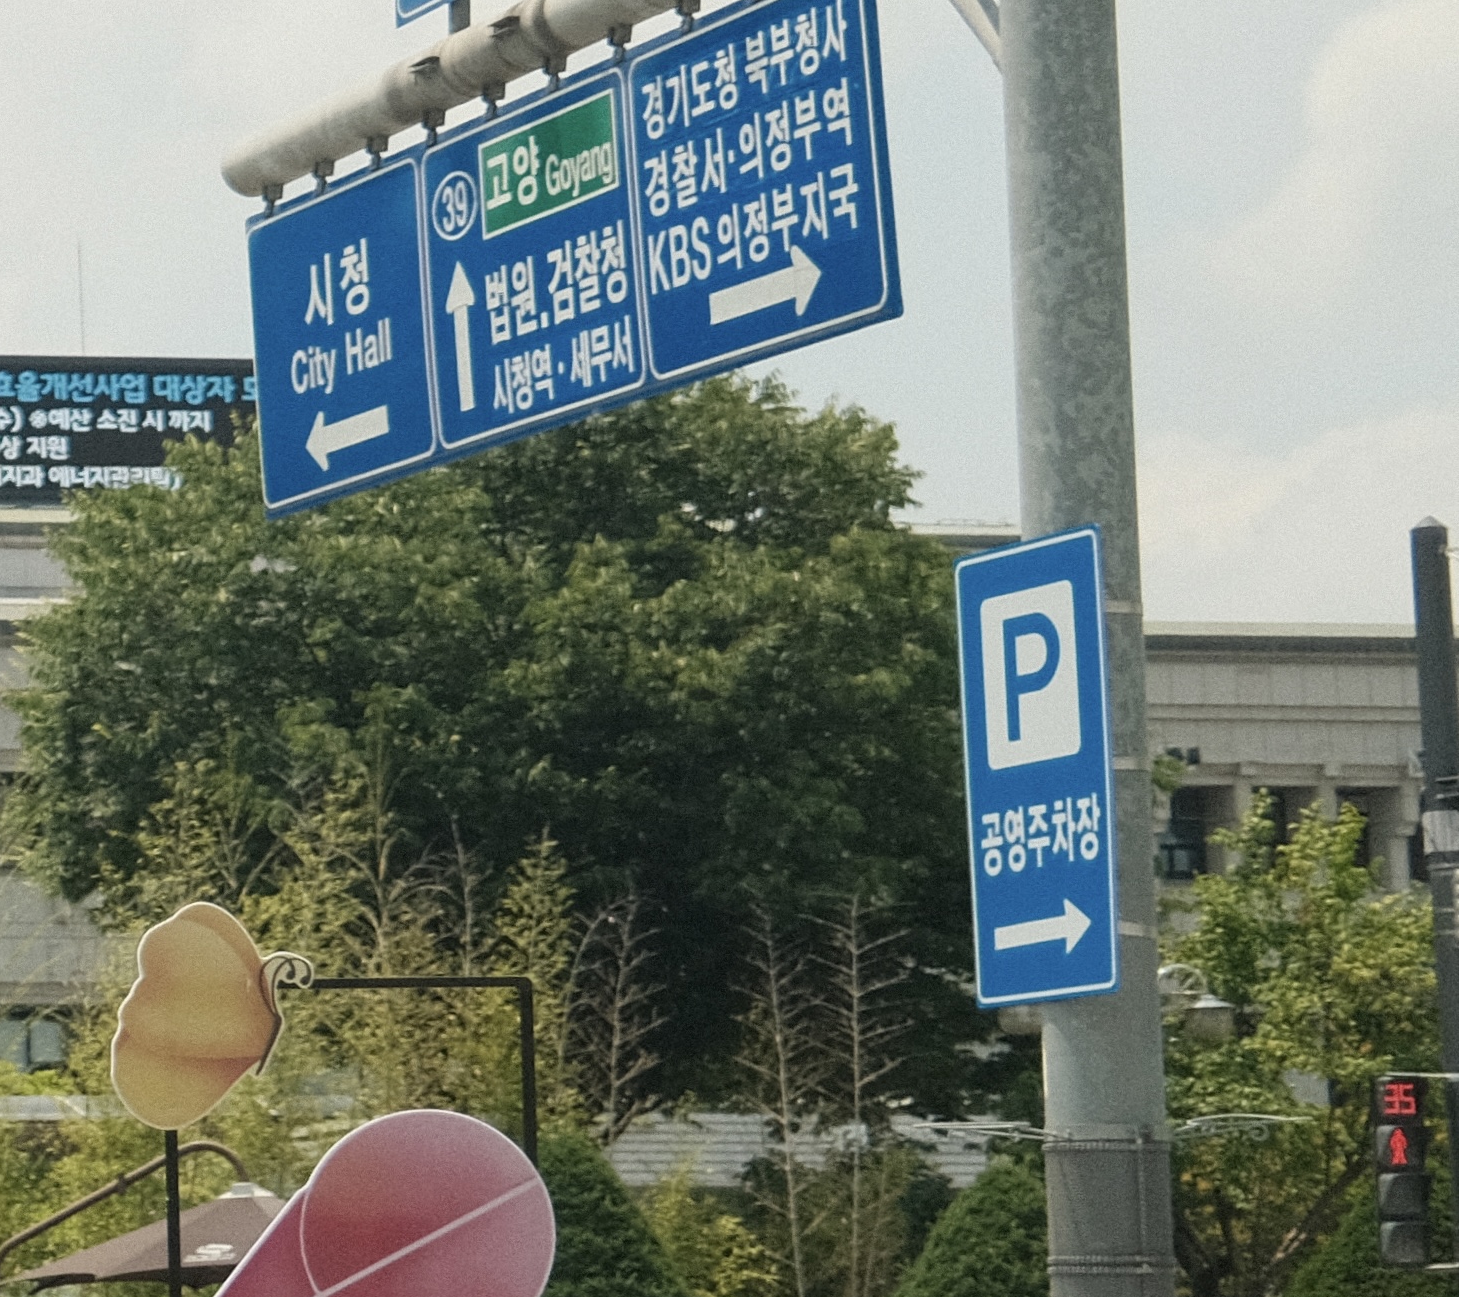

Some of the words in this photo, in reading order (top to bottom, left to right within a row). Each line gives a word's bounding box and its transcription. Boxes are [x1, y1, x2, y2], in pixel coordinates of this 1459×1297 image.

[642, 43, 739, 139] 경기도청
[440, 180, 469, 233] 39
[485, 136, 540, 210] 고양
[545, 141, 613, 198] Goyang
[648, 216, 712, 295] KBS
[717, 163, 859, 269] 의정부지국
[304, 238, 370, 326] 시청
[153, 374, 235, 405] 대상자
[291, 346, 337, 395] City
[345, 318, 392, 375] Hall
[26, 435, 70, 460] 지원
[1002, 612, 1061, 742] P
[981, 792, 1101, 876] 공영주차장
[1384, 1084, 1417, 1114] 35
